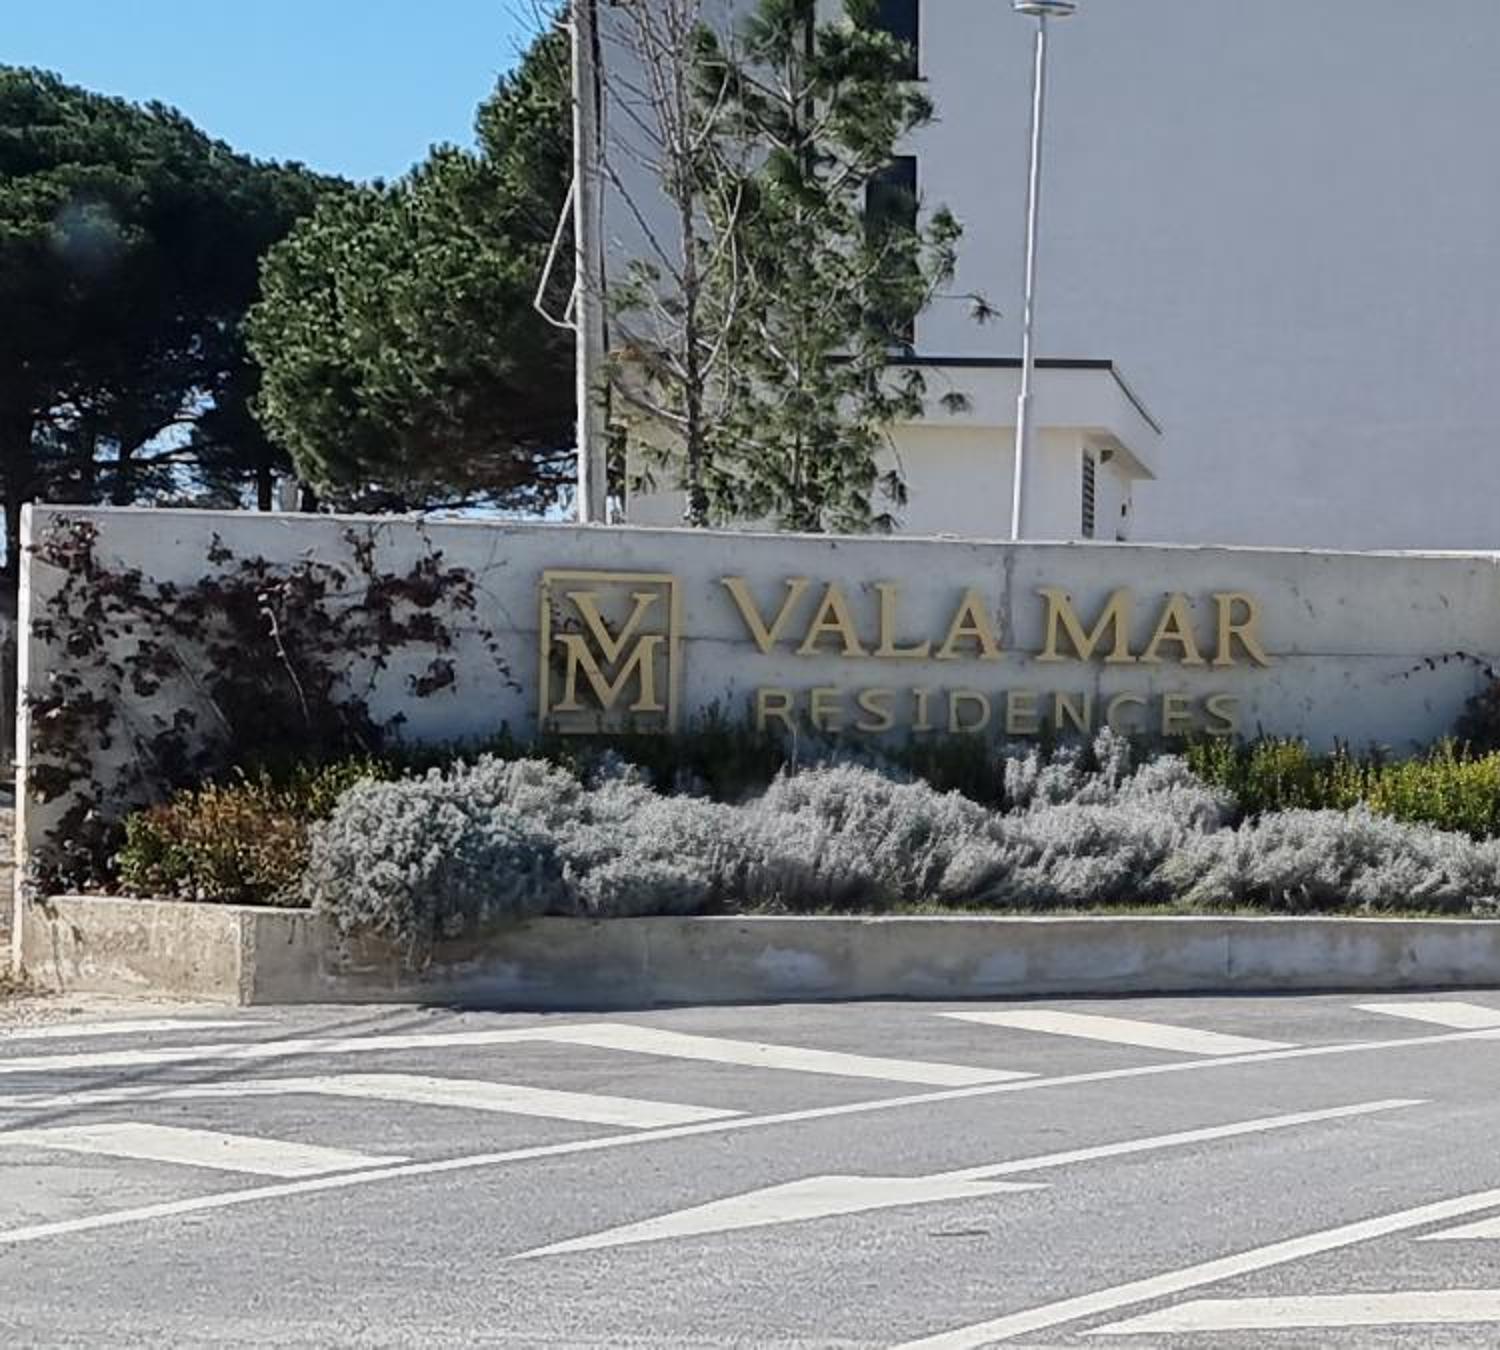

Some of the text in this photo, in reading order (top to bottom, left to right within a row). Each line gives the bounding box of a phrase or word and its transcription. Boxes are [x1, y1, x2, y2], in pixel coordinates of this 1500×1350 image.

[721, 575, 1274, 667] VALA MAR
[757, 687, 1241, 736] RESIDENCES
